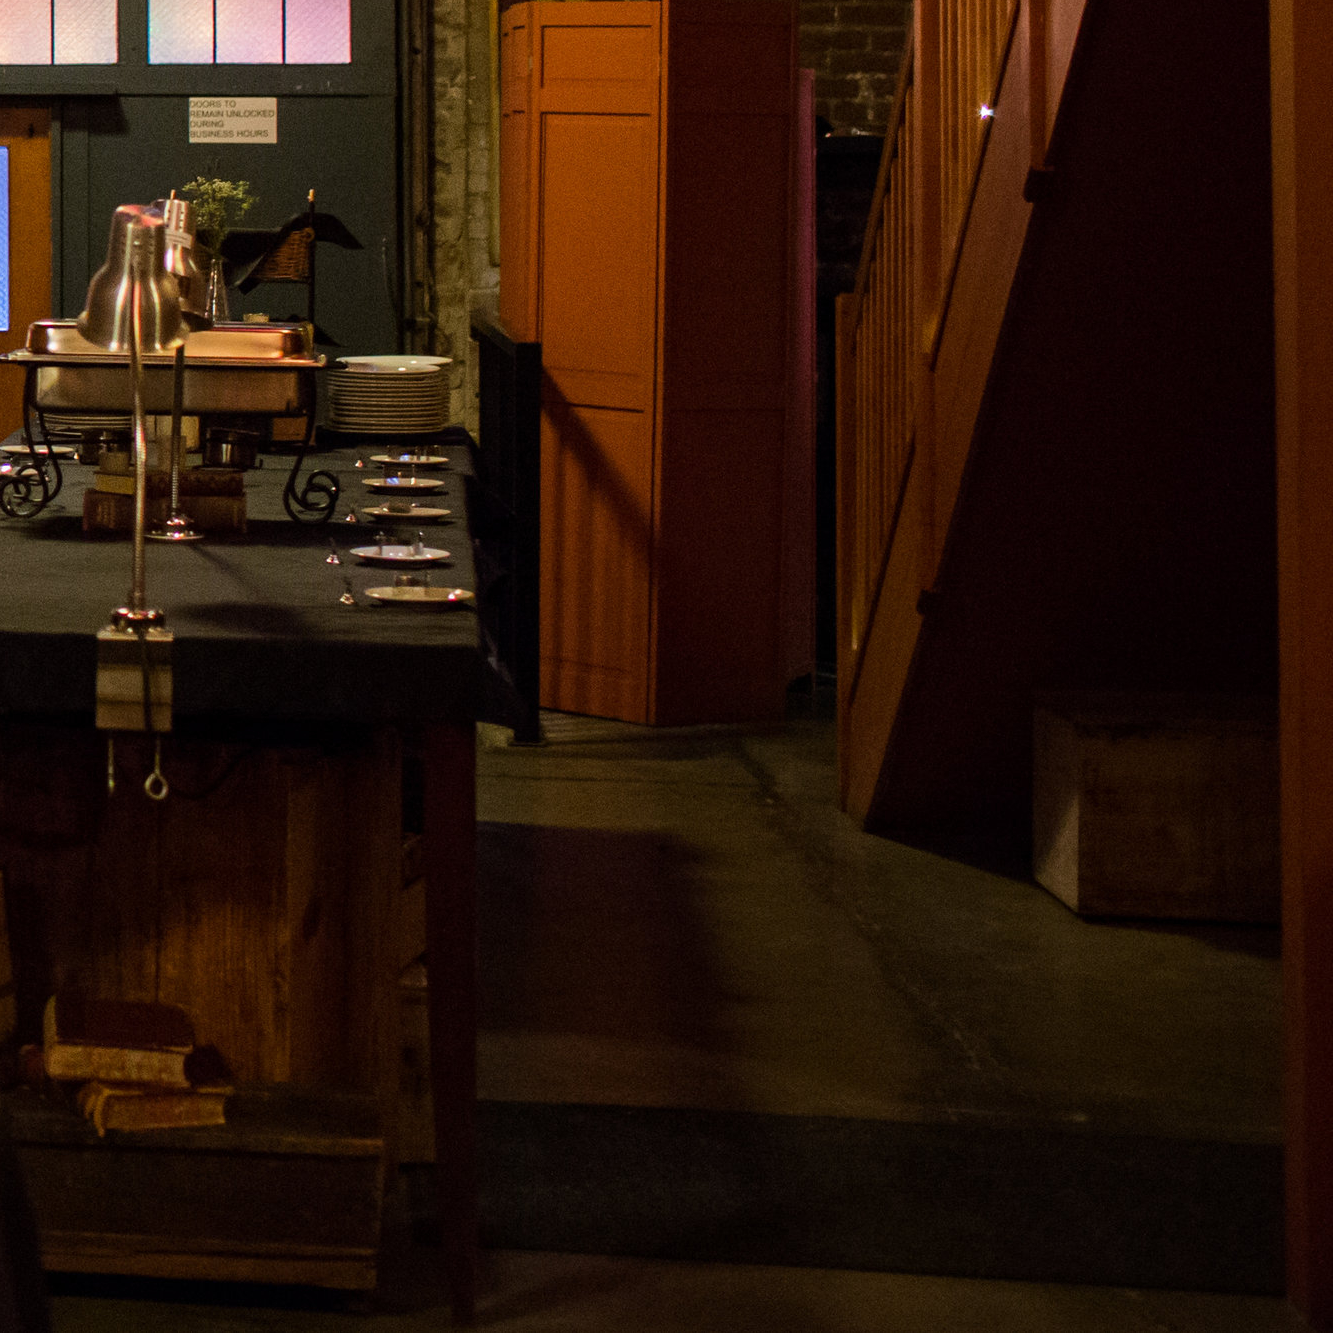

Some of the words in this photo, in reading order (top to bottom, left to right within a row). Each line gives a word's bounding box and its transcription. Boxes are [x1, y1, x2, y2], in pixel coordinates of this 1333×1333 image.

[190, 100, 222, 108] DOORS
[225, 100, 236, 108] TO
[190, 110, 223, 118] REMAIN
[226, 110, 275, 118] UNLOCKED
[190, 120, 224, 128] DURING
[190, 130, 234, 138] BUSINESS
[237, 130, 269, 138] HOURS
